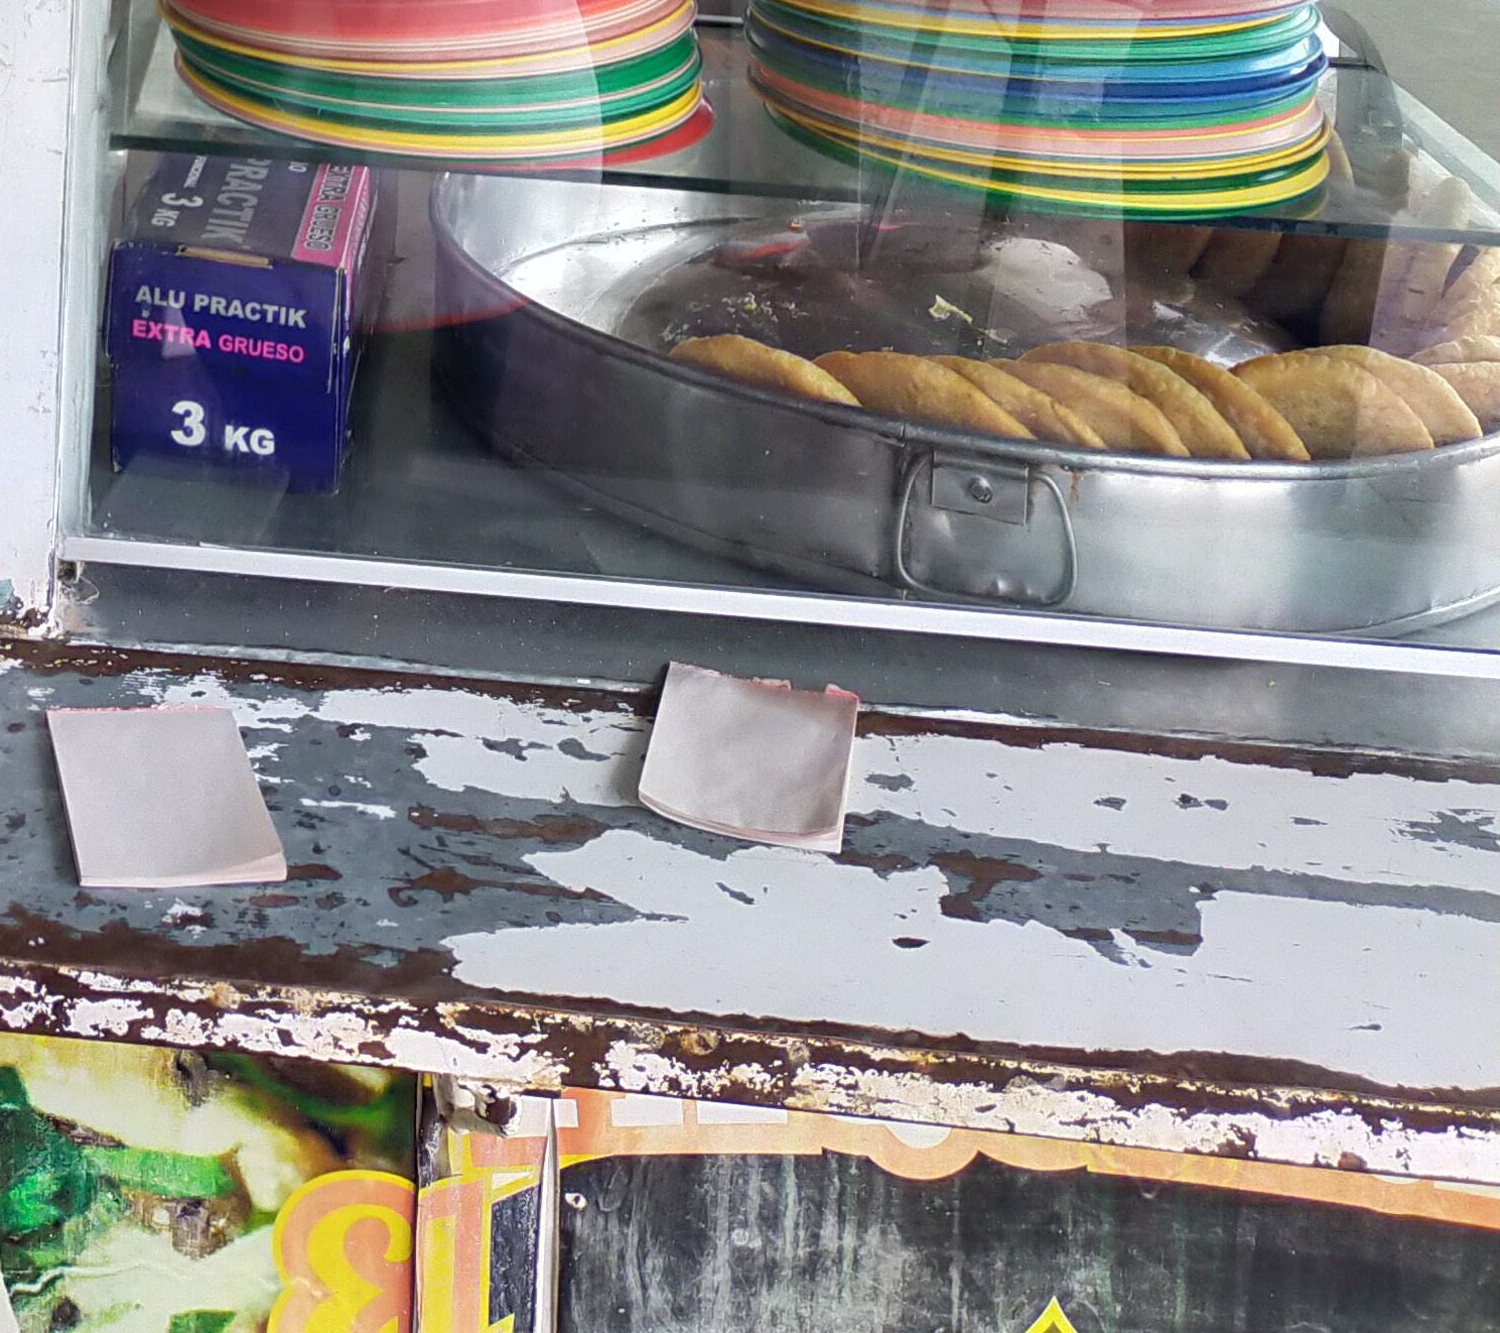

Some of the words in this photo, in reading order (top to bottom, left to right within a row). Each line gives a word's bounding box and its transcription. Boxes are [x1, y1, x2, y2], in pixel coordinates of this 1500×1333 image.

[161, 192, 204, 208] 3
[319, 165, 352, 202] EXTRA
[151, 208, 180, 228] KG
[303, 203, 341, 251] GRUESO
[135, 285, 186, 310] ALU
[193, 293, 308, 329] PRACTIK
[132, 318, 212, 350] EXTRA
[218, 334, 305, 364] GRUESO
[170, 400, 206, 447] 3
[224, 424, 276, 456] KG
